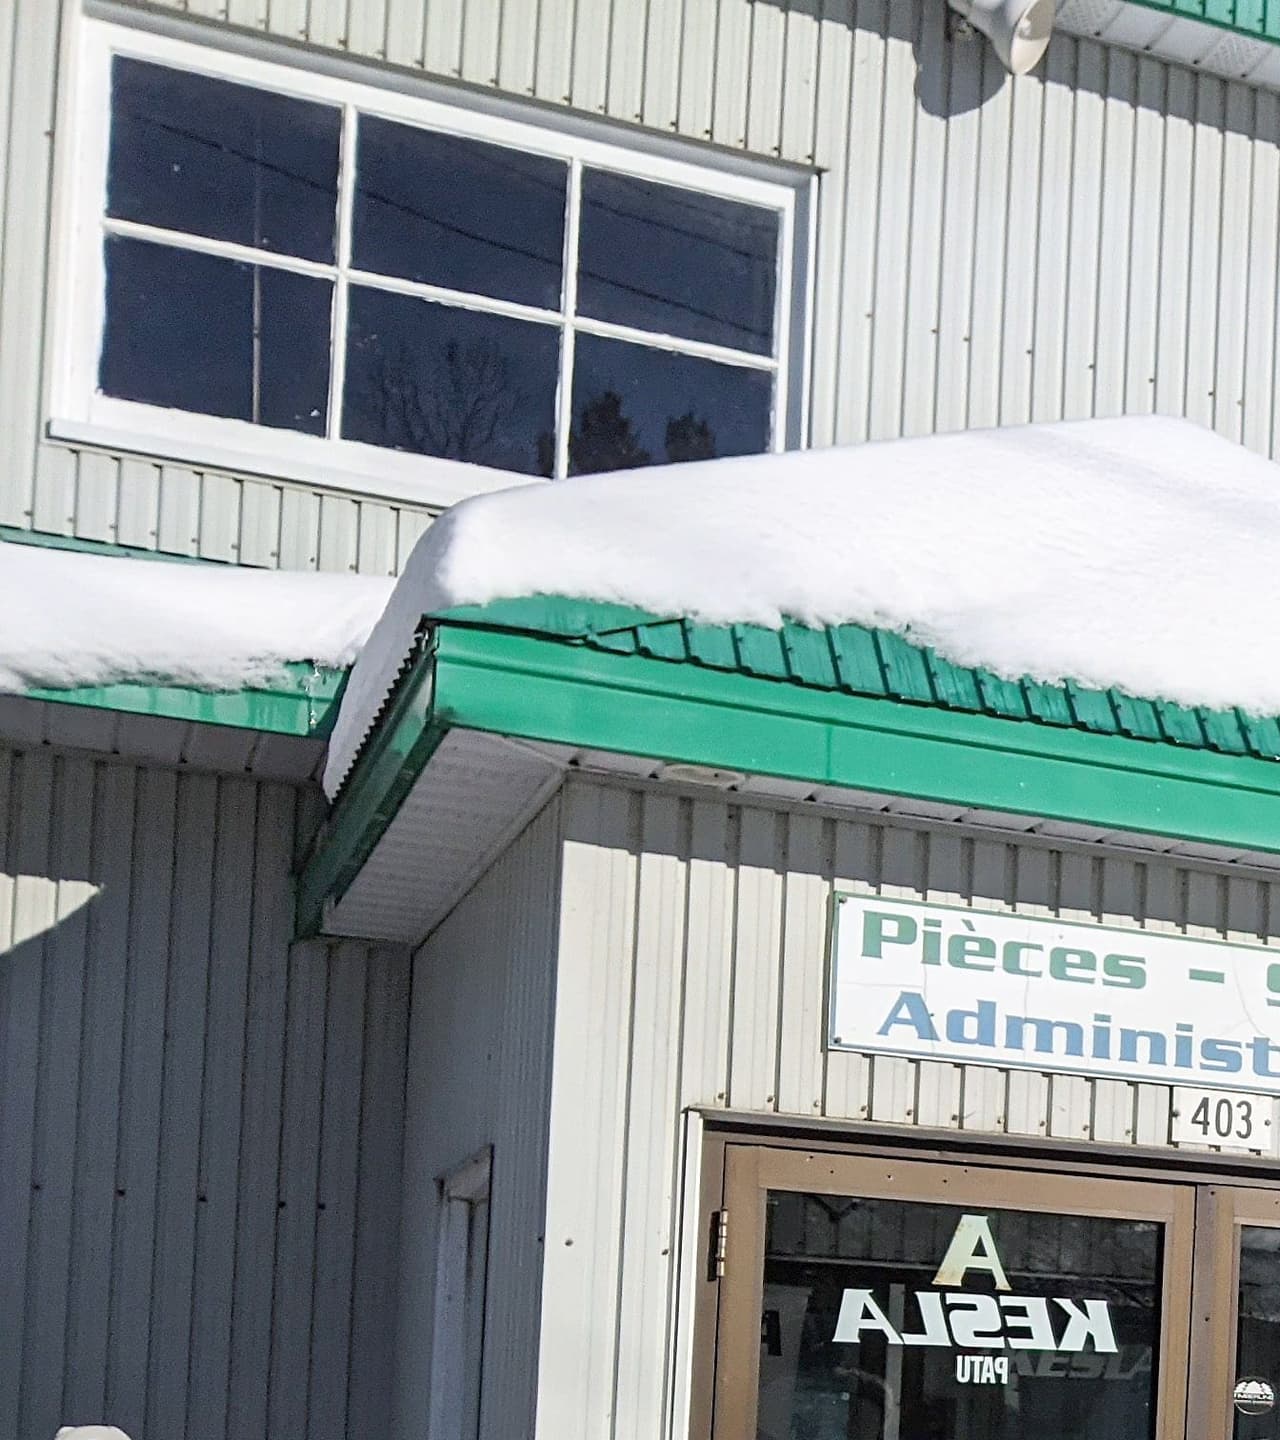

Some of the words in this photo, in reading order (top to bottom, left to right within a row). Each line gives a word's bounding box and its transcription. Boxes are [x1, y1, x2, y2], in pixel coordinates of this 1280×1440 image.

[861, 910, 1146, 989] Pièces
[1189, 968, 1225, 983] -
[1191, 1097, 1252, 1139] 403
[931, 1215, 1012, 1291] A
